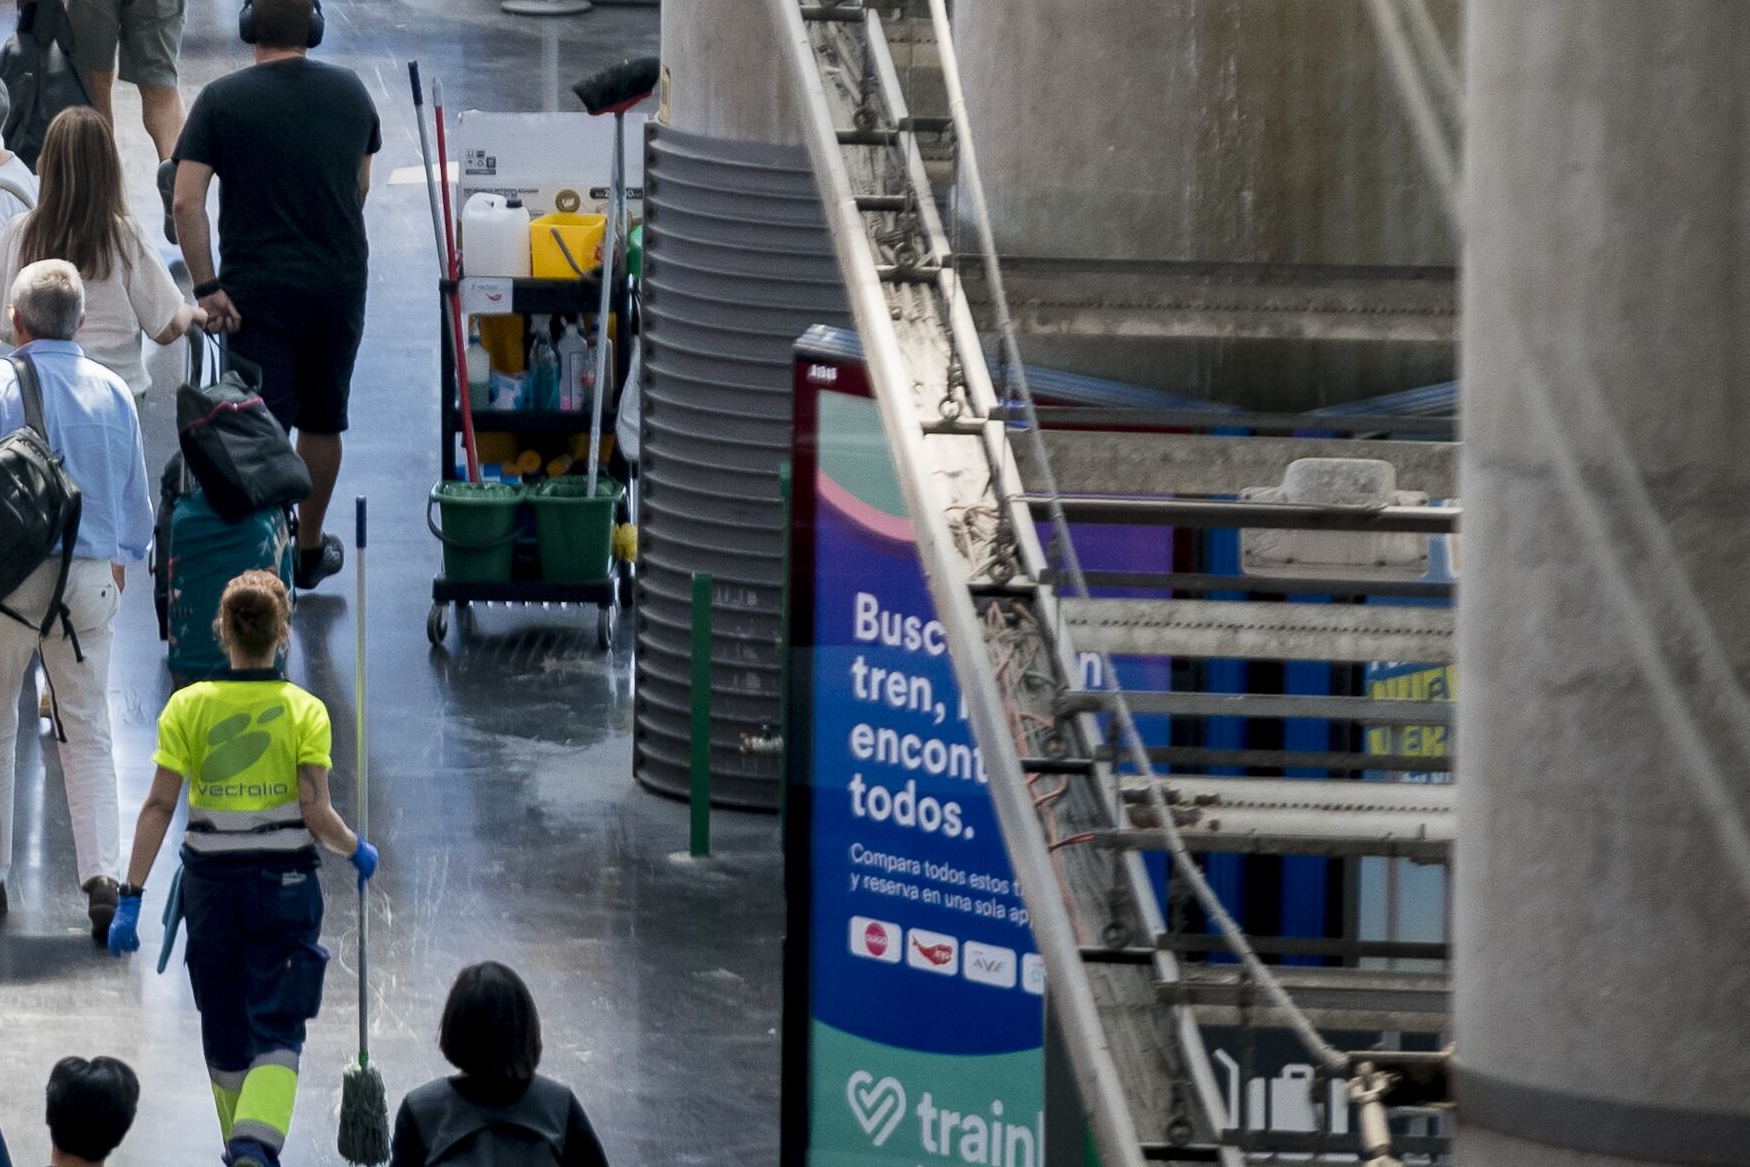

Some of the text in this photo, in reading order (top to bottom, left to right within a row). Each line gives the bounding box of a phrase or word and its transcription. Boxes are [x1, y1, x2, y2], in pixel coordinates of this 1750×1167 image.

[851, 654, 947, 725] tren,
[198, 782, 288, 796] vectalia
[848, 771, 976, 840] todos.
[850, 842, 921, 876] Compara
[924, 860, 966, 885] todos
[970, 872, 1010, 896] estos
[850, 872, 860, 892] y
[863, 874, 919, 901] reserva
[922, 887, 941, 904] en
[944, 893, 972, 912] una
[975, 898, 1006, 920] sola
